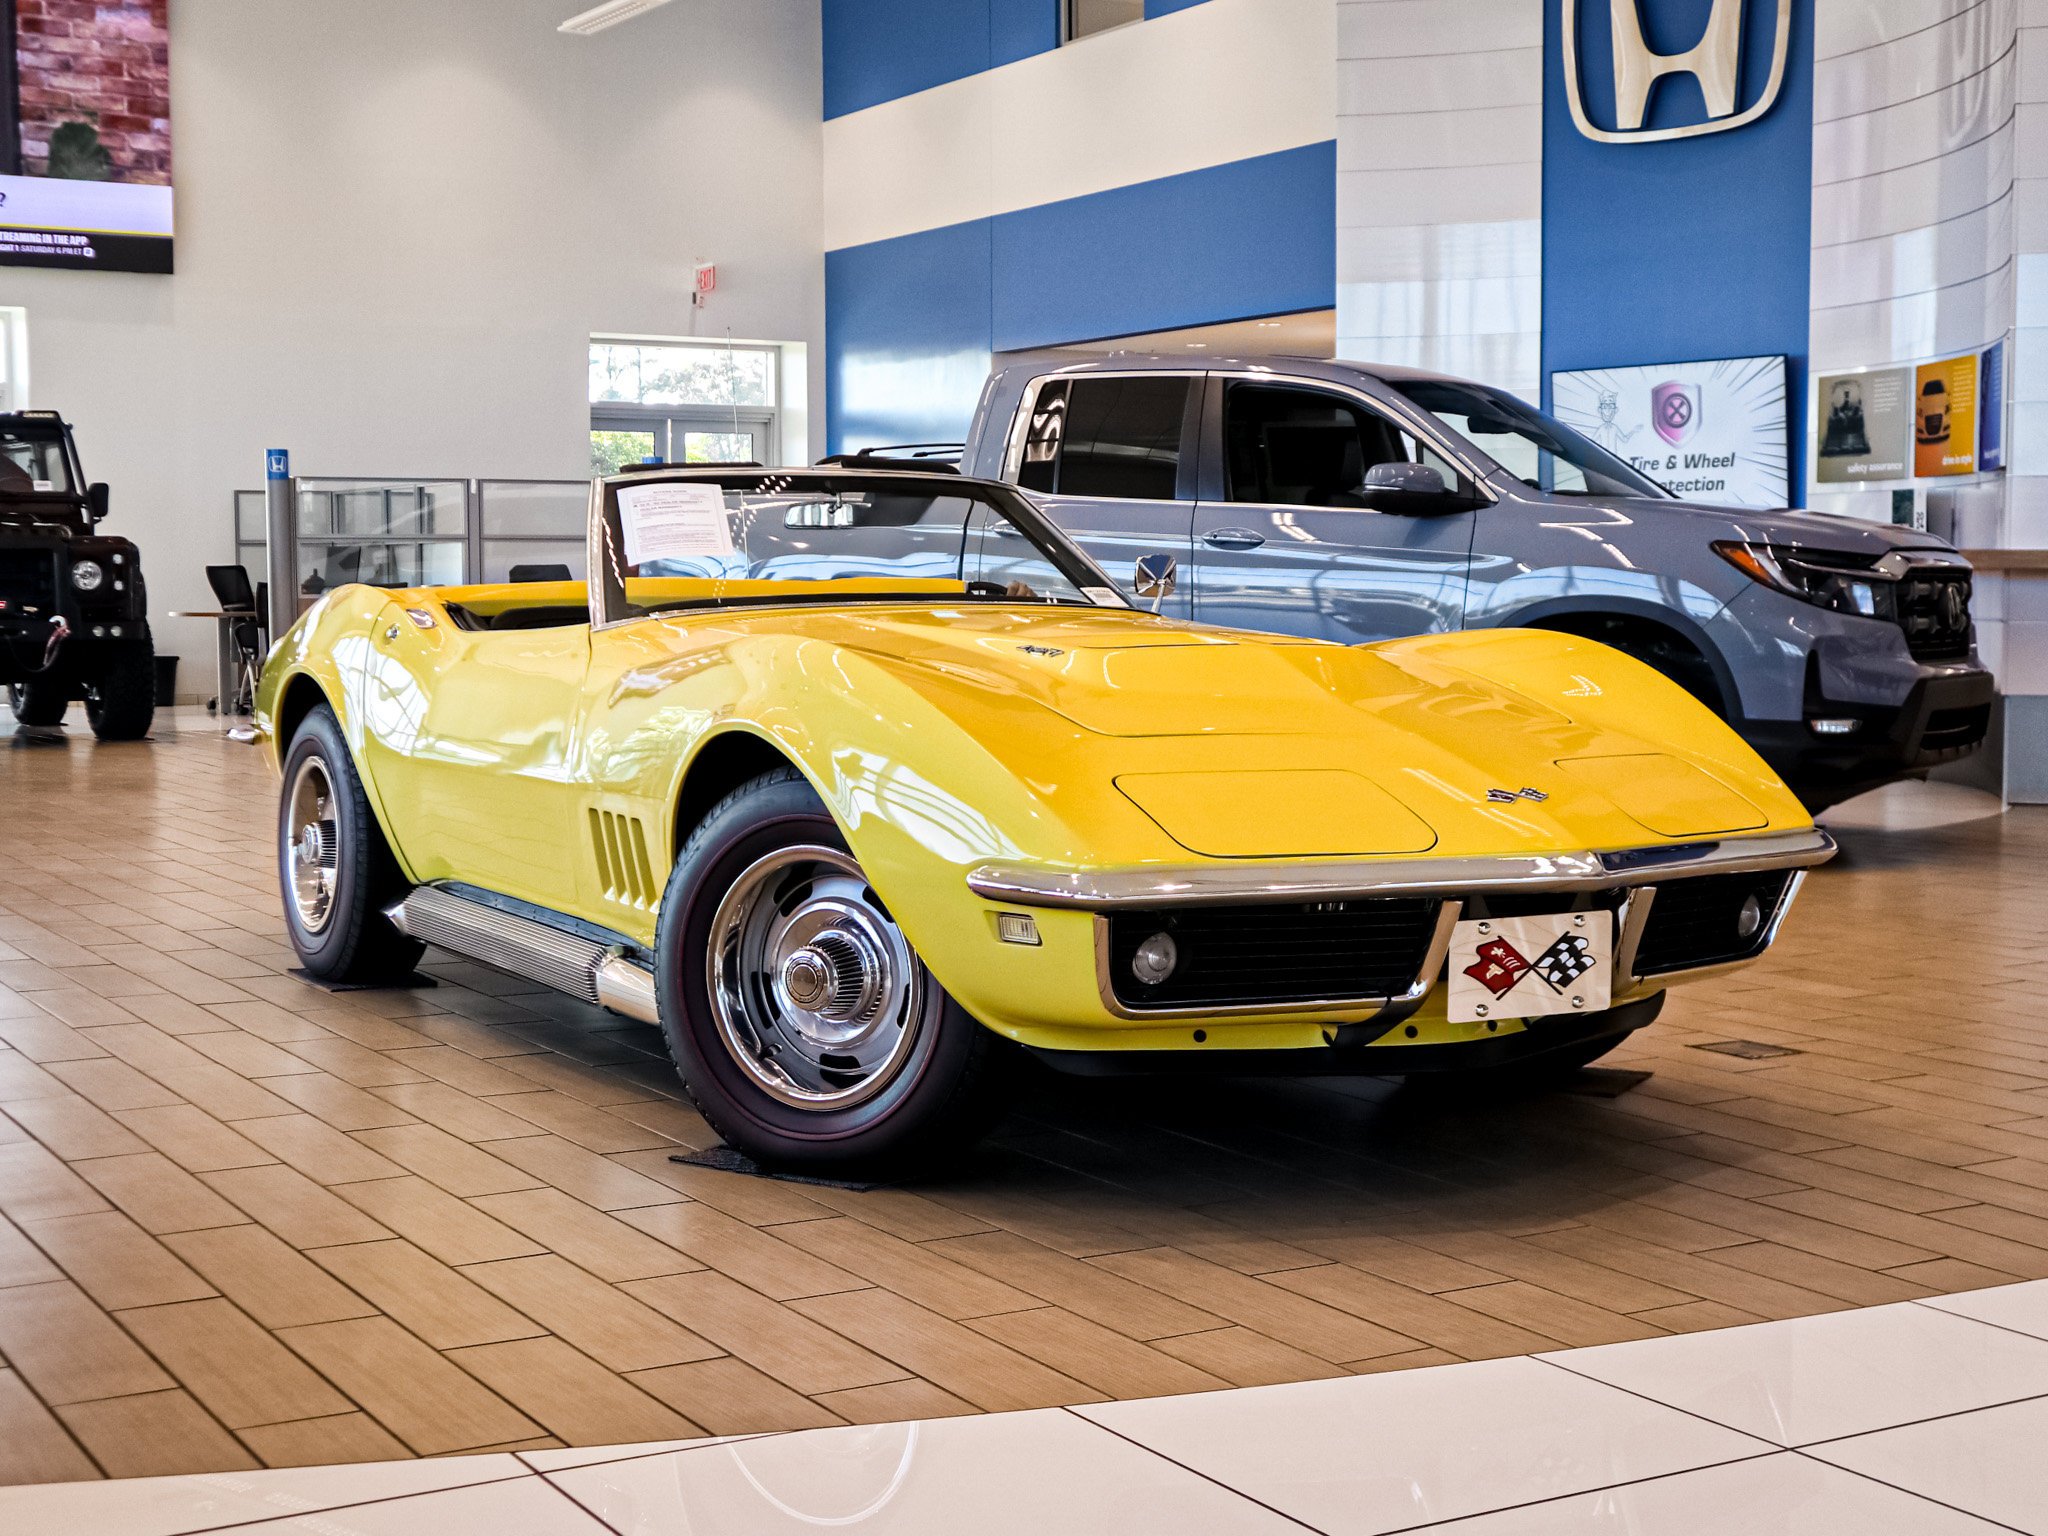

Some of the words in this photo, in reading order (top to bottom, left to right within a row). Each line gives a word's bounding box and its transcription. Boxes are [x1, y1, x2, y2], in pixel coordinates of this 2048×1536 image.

[53, 234, 69, 245] THE
[69, 235, 89, 247] APP
[20, 244, 55, 253] SATURDAY
[1630, 456, 1660, 471] Tire
[1665, 454, 1678, 470] &
[1684, 451, 1736, 469] Wheel
[1847, 462, 1868, 475] safety
